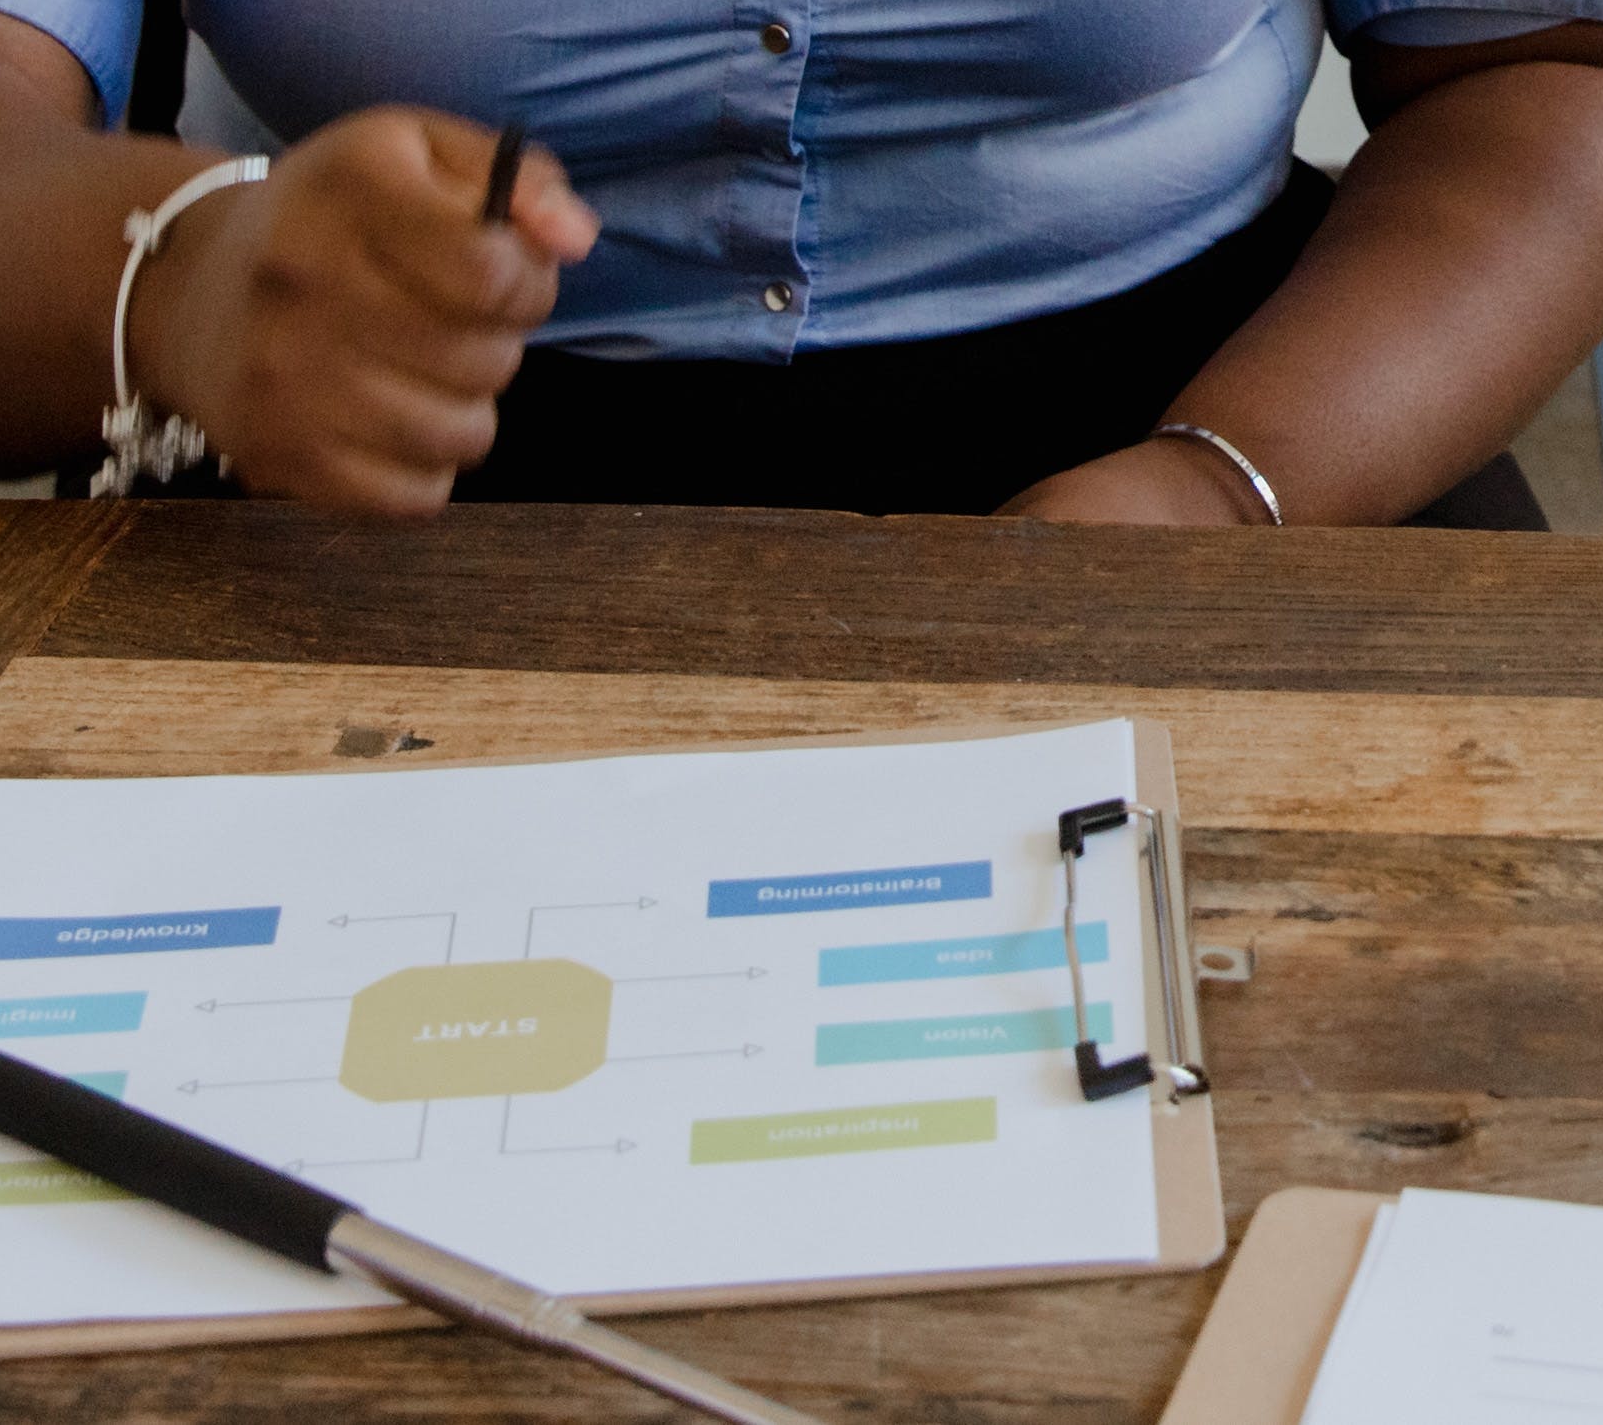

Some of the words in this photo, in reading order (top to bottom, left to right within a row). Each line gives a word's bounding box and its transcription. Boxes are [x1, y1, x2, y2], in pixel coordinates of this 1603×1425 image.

[757, 876, 942, 902] Brainstorming
[56, 923, 209, 944] Knowledge
[936, 949, 994, 964] Idea
[412, 1016, 539, 1043] START
[924, 1025, 1008, 1041] Vision
[768, 1117, 919, 1143] Inspiration
